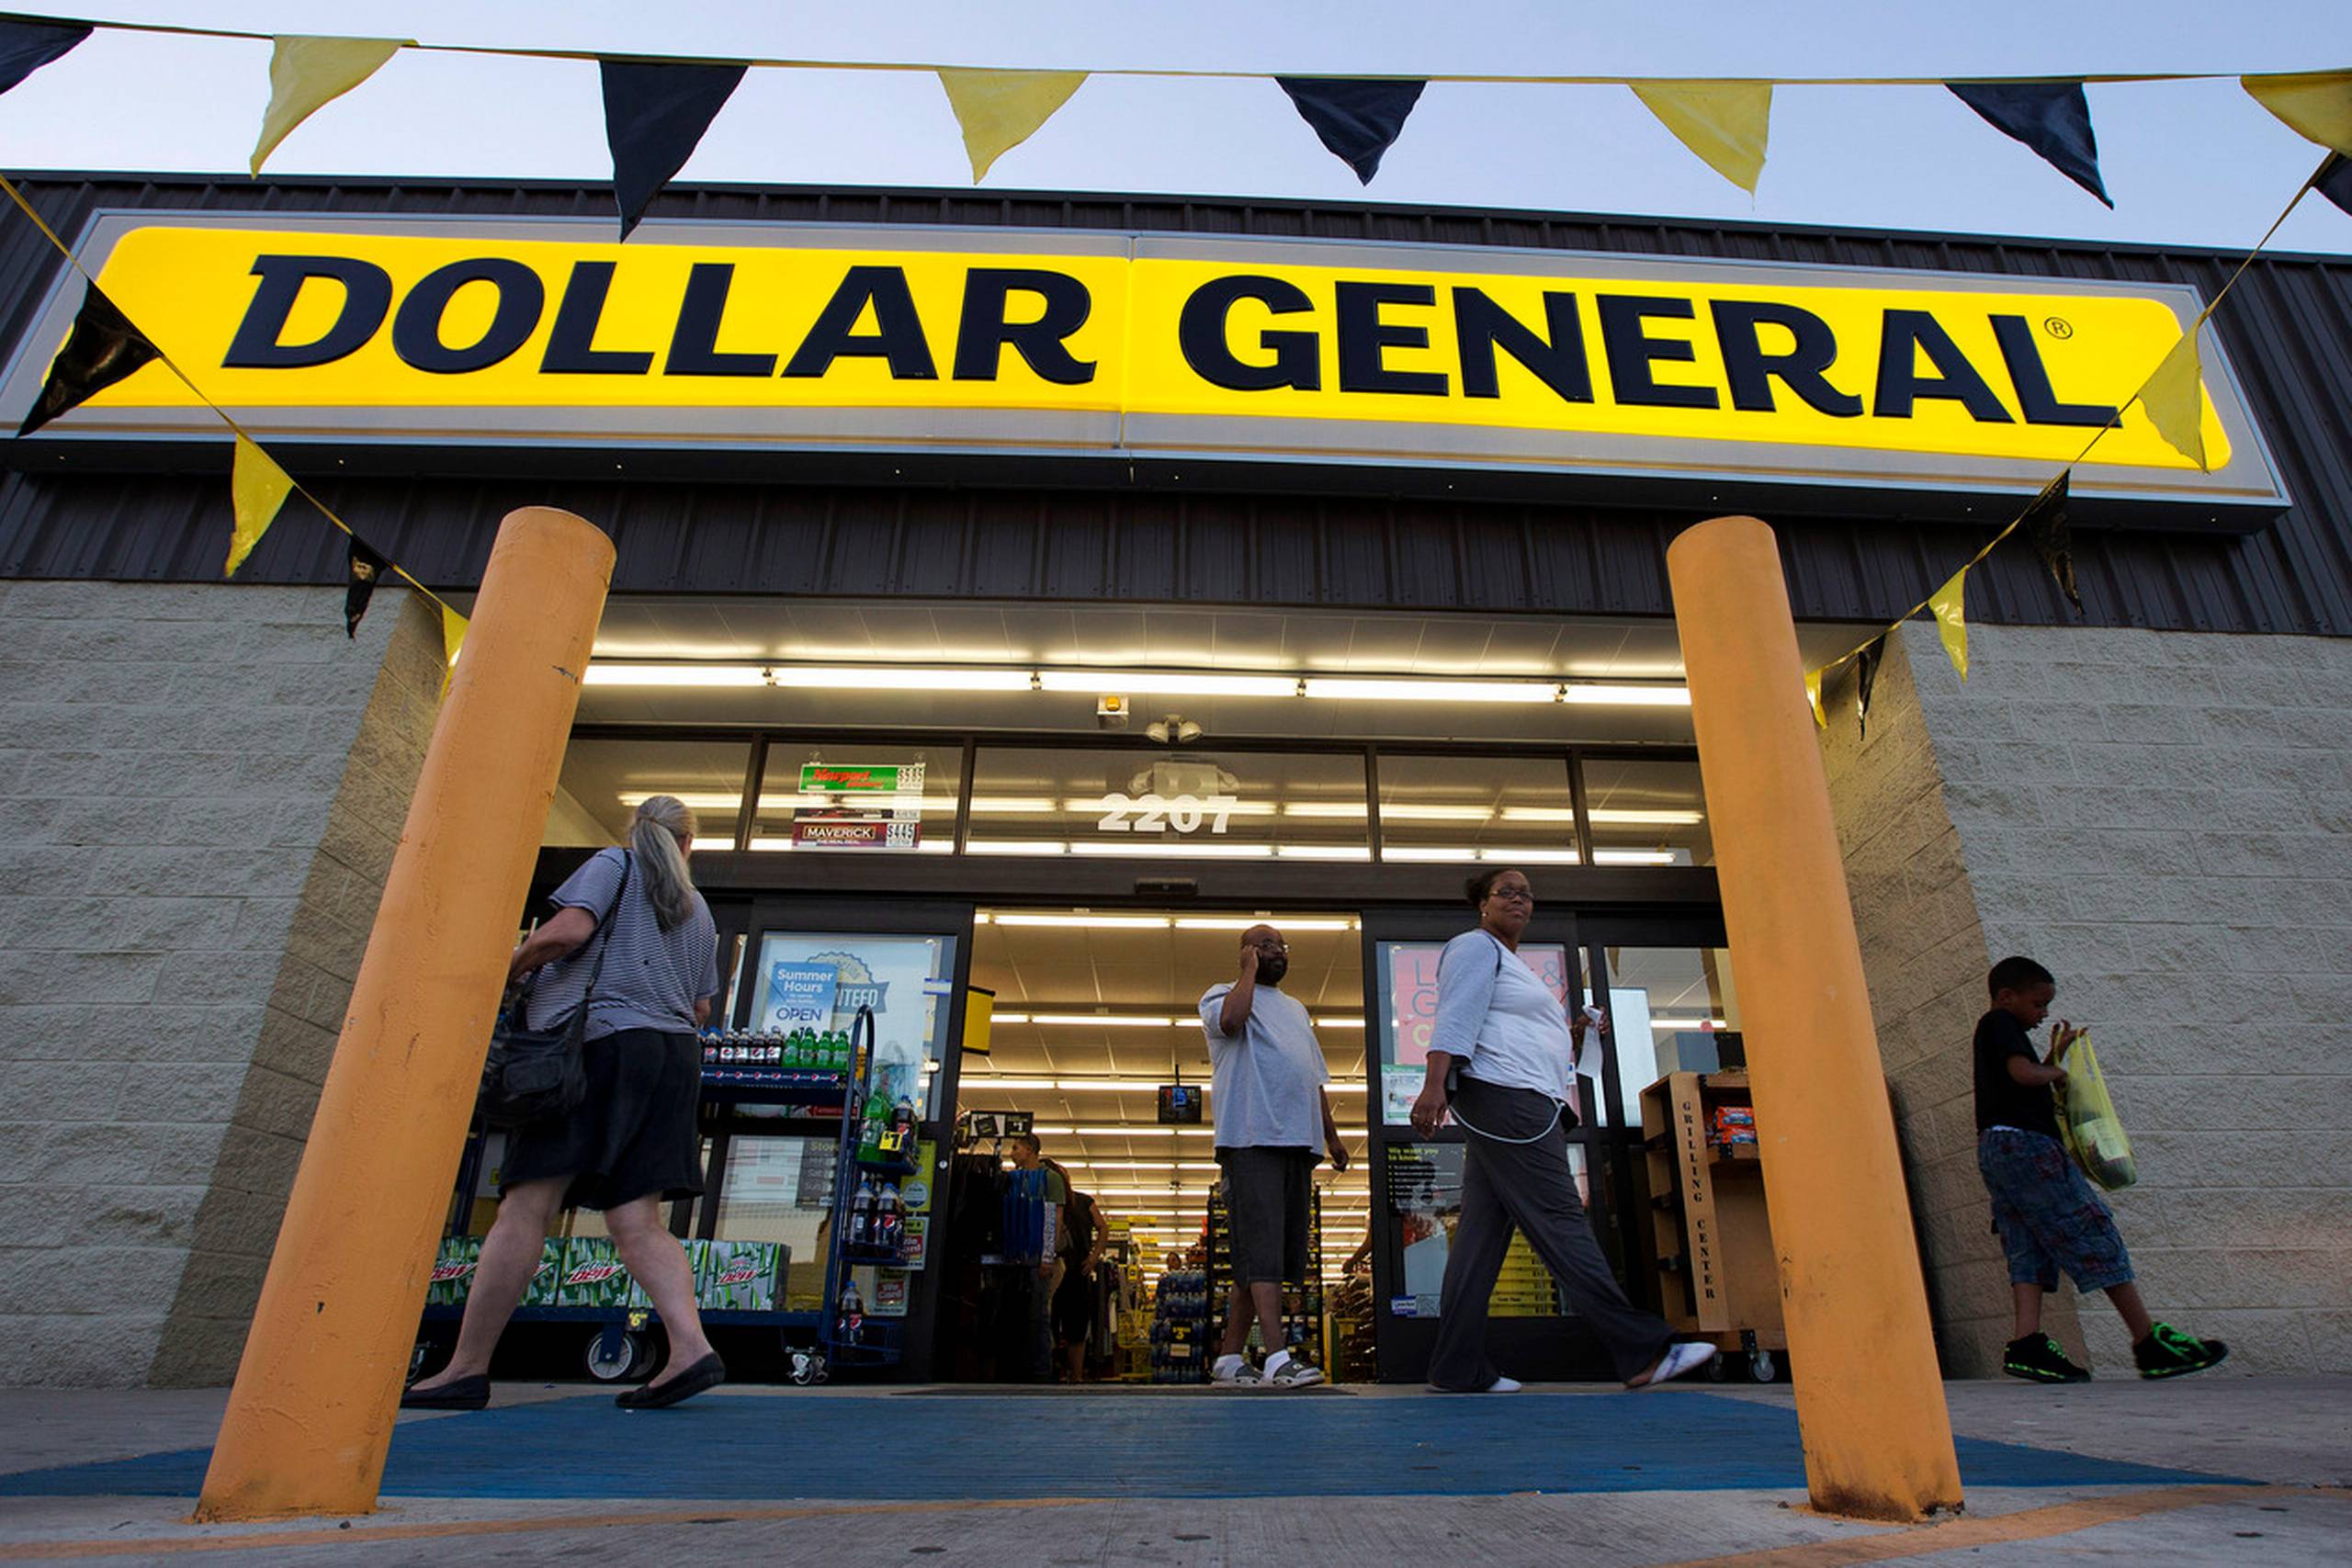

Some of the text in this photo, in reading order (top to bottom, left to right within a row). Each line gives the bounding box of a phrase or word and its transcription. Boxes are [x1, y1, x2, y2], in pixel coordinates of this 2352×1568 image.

[220, 254, 1098, 386] DOLLAR
[1179, 274, 2124, 429] GENERAL
[1098, 793, 1238, 834] 2207
[807, 827, 872, 839] MAVERICK
[777, 969, 834, 982] Summer
[783, 981, 824, 994] Hours
[775, 1007, 823, 1022] OPEN
[1682, 1101, 1716, 1301] GRILLING CENTER
